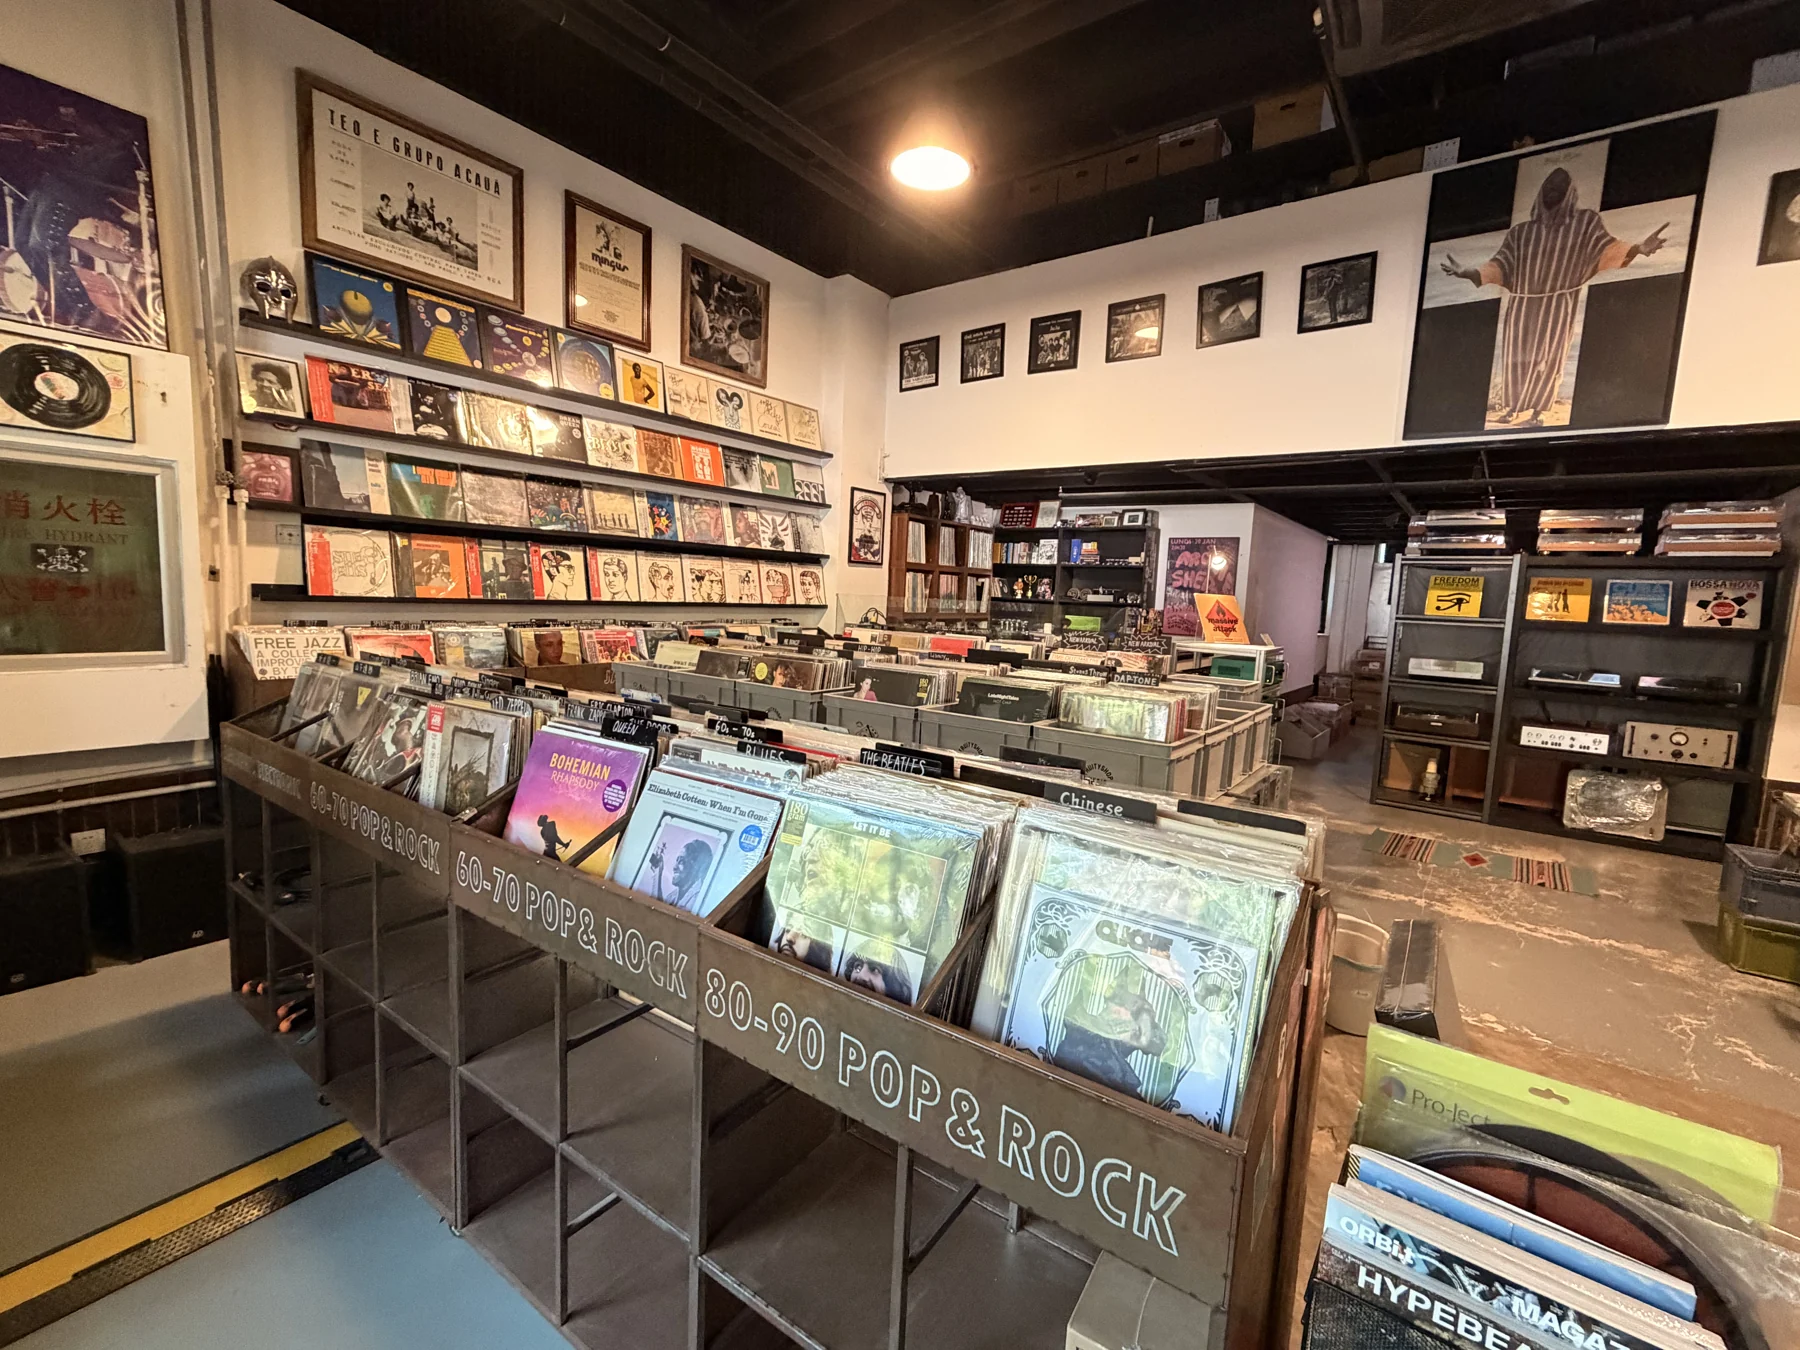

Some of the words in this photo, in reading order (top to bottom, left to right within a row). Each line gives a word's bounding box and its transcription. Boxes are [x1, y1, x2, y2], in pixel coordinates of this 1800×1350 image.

[328, 108, 361, 137] TEO
[373, 128, 381, 145] E
[393, 136, 444, 172] GRUPO
[591, 251, 629, 272] mingus
[1433, 576, 1480, 585] FREEDOM
[1690, 580, 1727, 589] BOSSA
[1728, 580, 1760, 589] NOVA
[1207, 617, 1239, 625] massive
[254, 637, 296, 649] FREE
[303, 637, 342, 649] JAZZ
[857, 644, 882, 653] HIP-HOP
[256, 650, 264, 659] A
[271, 650, 317, 658] COLLEC
[272, 667, 289, 676] BY
[566, 703, 586, 720] FRANK
[606, 703, 634, 717] CLAPTON
[612, 720, 640, 736] QUEEN
[646, 720, 672, 734] DOORS
[715, 721, 730, 734] 60s
[741, 726, 755, 739] 70s
[746, 744, 785, 762] BLUES
[549, 752, 612, 781] BOHEMIAN
[861, 750, 879, 766] THE
[880, 752, 927, 777] BEATLES
[550, 770, 600, 791] RHAPSODY
[310, 781, 350, 827] 60-70
[647, 783, 682, 800] Elizabeth
[709, 799, 732, 814] When
[732, 806, 747, 818] I'm
[747, 810, 769, 823] Gone
[789, 800, 809, 816] 180
[1059, 790, 1124, 818] Chinese
[787, 812, 805, 822] gram
[852, 821, 867, 832] LET
[868, 824, 877, 834] IT
[879, 827, 892, 838] BE
[456, 850, 520, 913] 60-70
[704, 968, 825, 1071] 80-90
